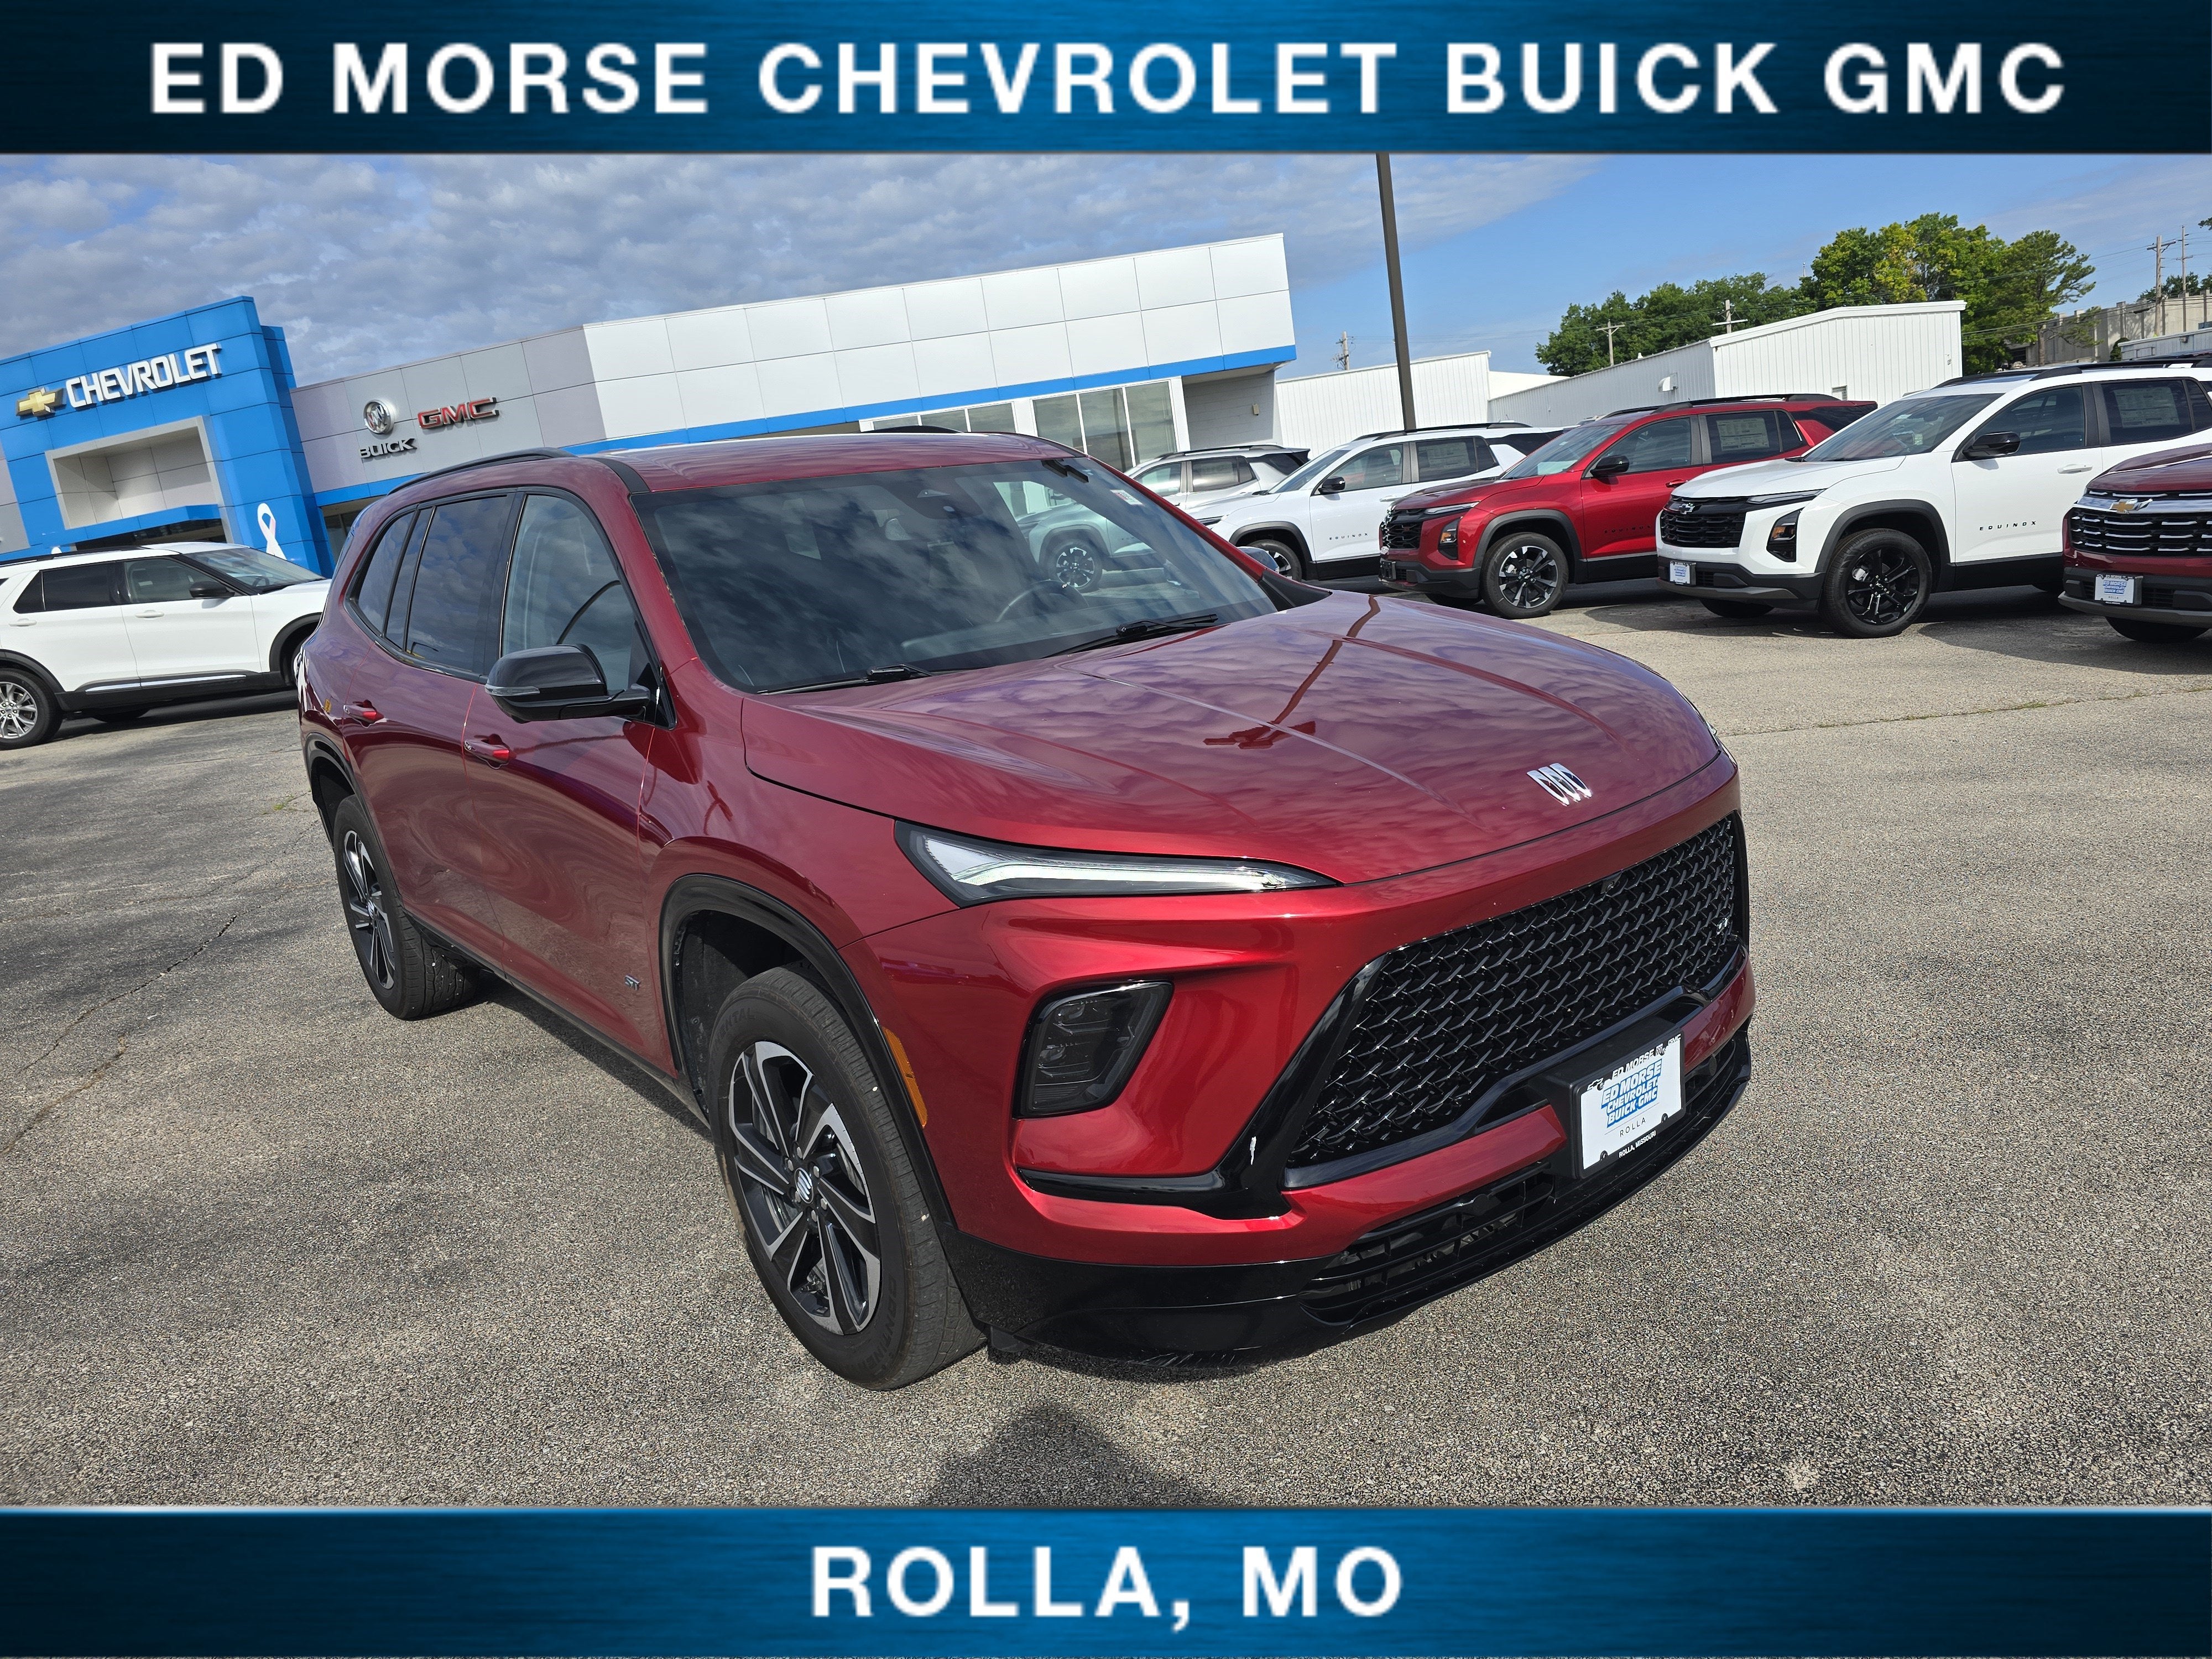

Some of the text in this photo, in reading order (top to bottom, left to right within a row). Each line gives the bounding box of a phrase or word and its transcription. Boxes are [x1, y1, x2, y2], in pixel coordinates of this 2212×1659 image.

[65, 343, 221, 408] CHEVROLET
[418, 397, 499, 430] GMC
[359, 439, 416, 459] BUICK
[1329, 532, 1368, 540] EQUINOX
[1979, 520, 2036, 531] EQUINOX
[1612, 1048, 1655, 1079] ED MORSE
[1602, 1059, 1662, 1107] ED MORSE
[1606, 1076, 1658, 1114] CHEVROLET
[1608, 1086, 1658, 1126] BUICK GMC
[1619, 1117, 1646, 1138] ROLLA
[1618, 1130, 1657, 1159] ROLLA, MISSOURI
